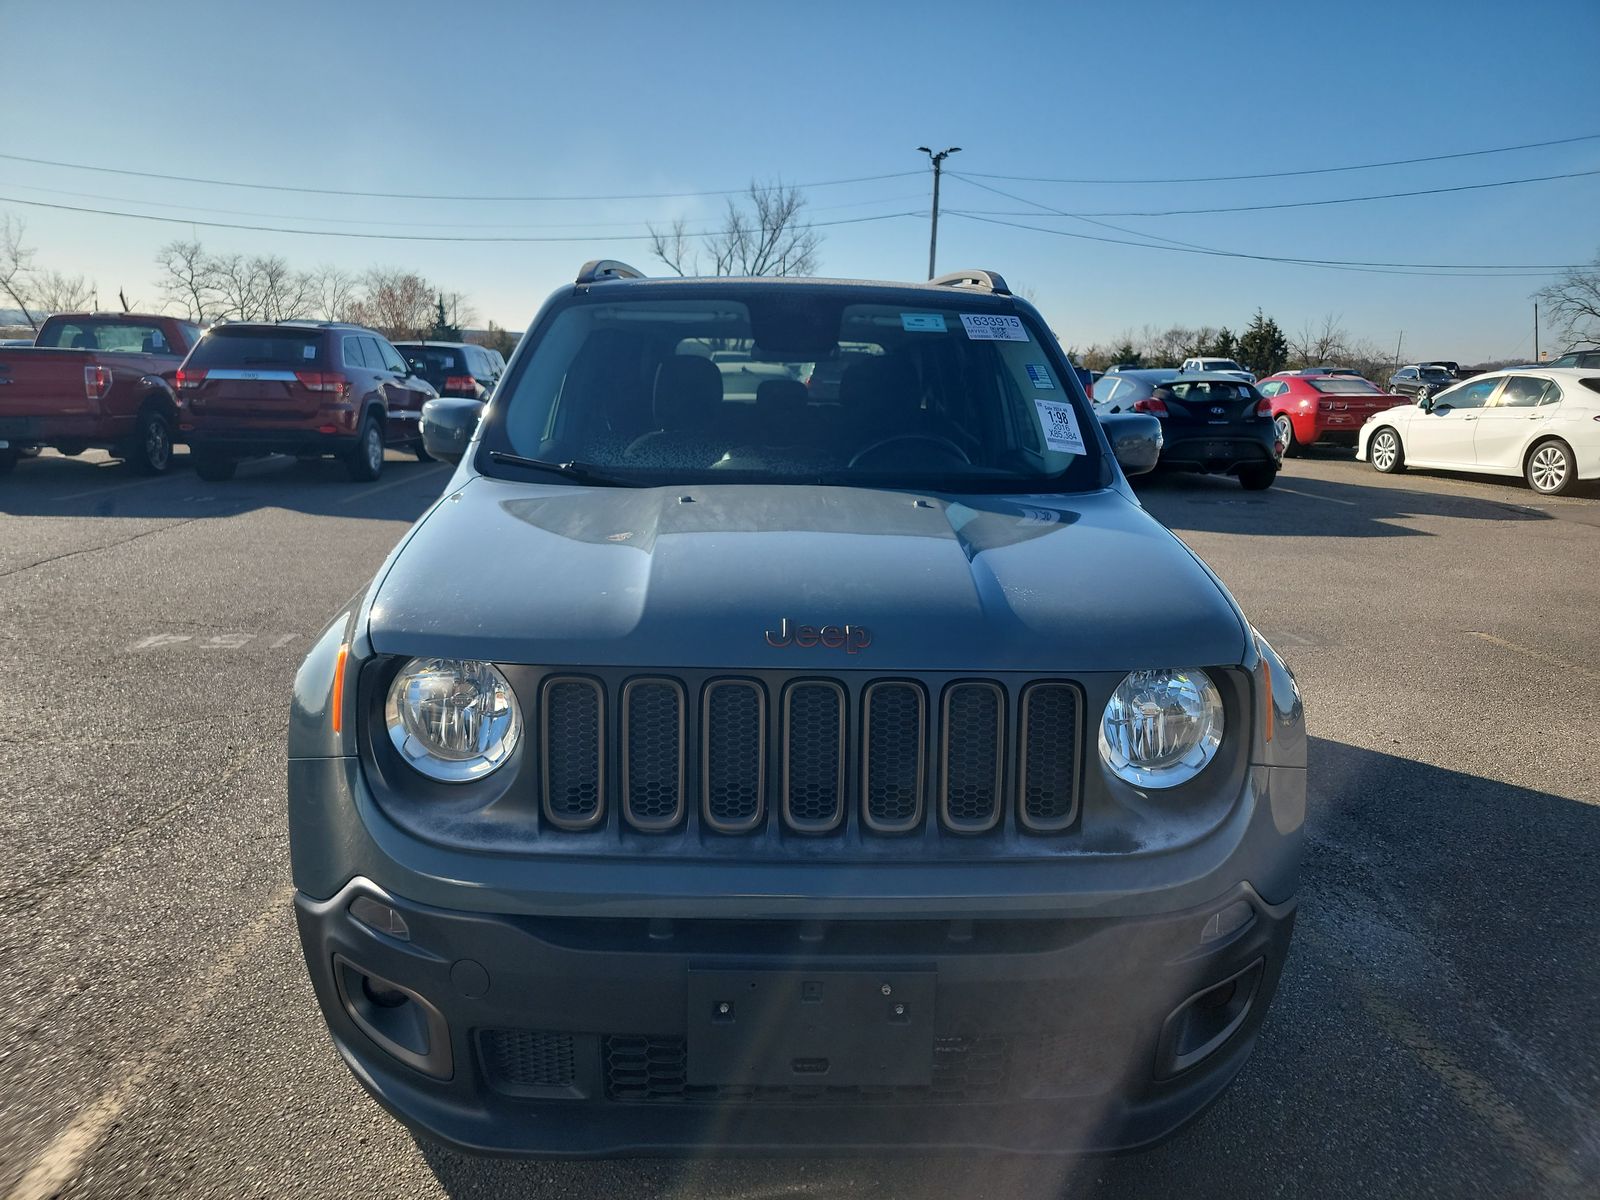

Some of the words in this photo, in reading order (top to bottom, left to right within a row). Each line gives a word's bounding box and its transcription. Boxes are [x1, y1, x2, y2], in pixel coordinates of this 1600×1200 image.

[966, 317, 1019, 327] 1633915
[1048, 410, 1068, 424] 1:98
[1053, 423, 1070, 432] 2016
[766, 618, 871, 654] Jeep
